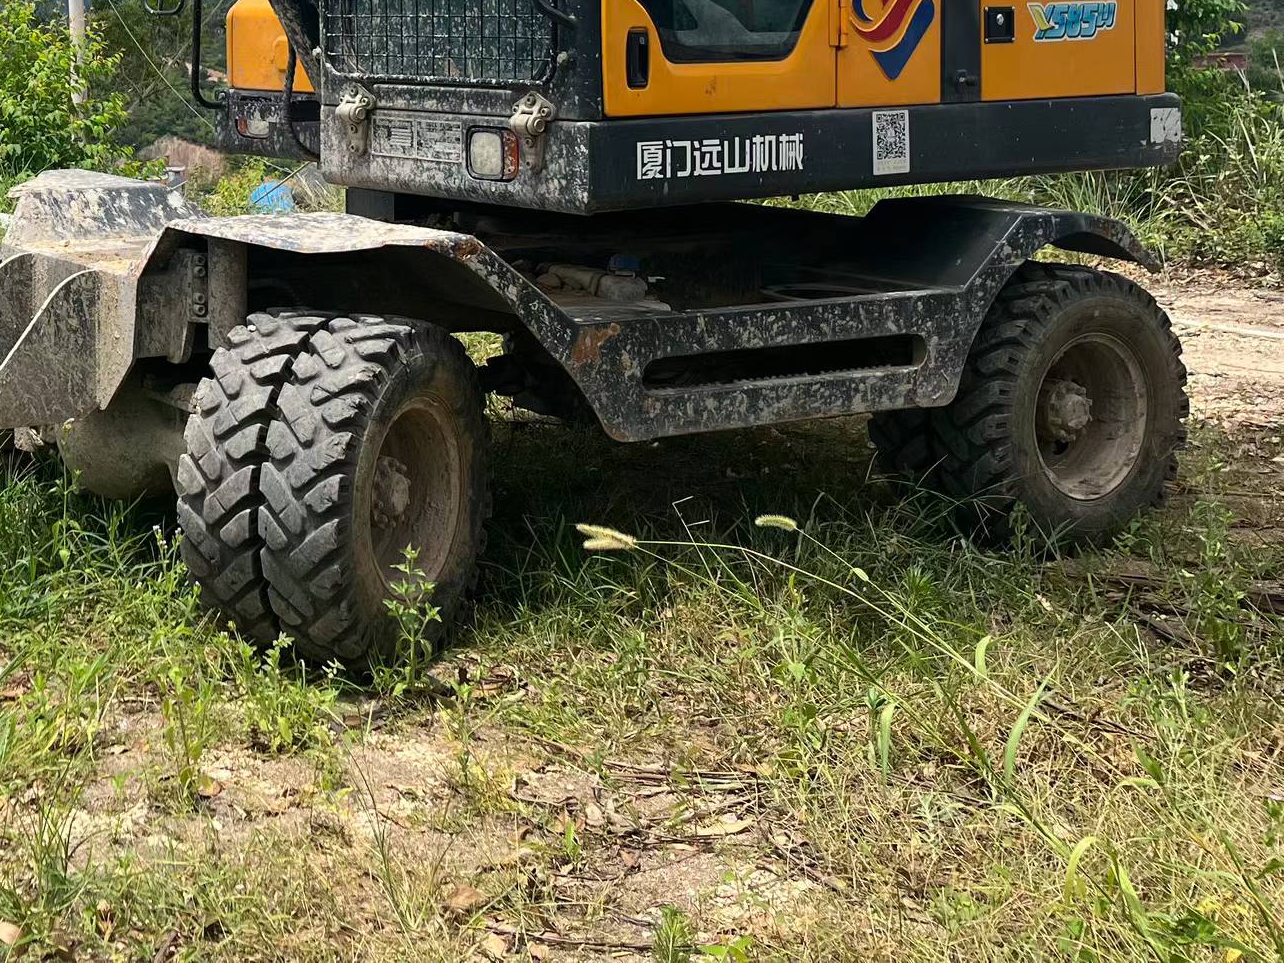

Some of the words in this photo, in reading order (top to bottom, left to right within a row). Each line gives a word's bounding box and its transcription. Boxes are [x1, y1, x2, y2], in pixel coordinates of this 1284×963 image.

[636, 132, 804, 180] 厦门远山机械
